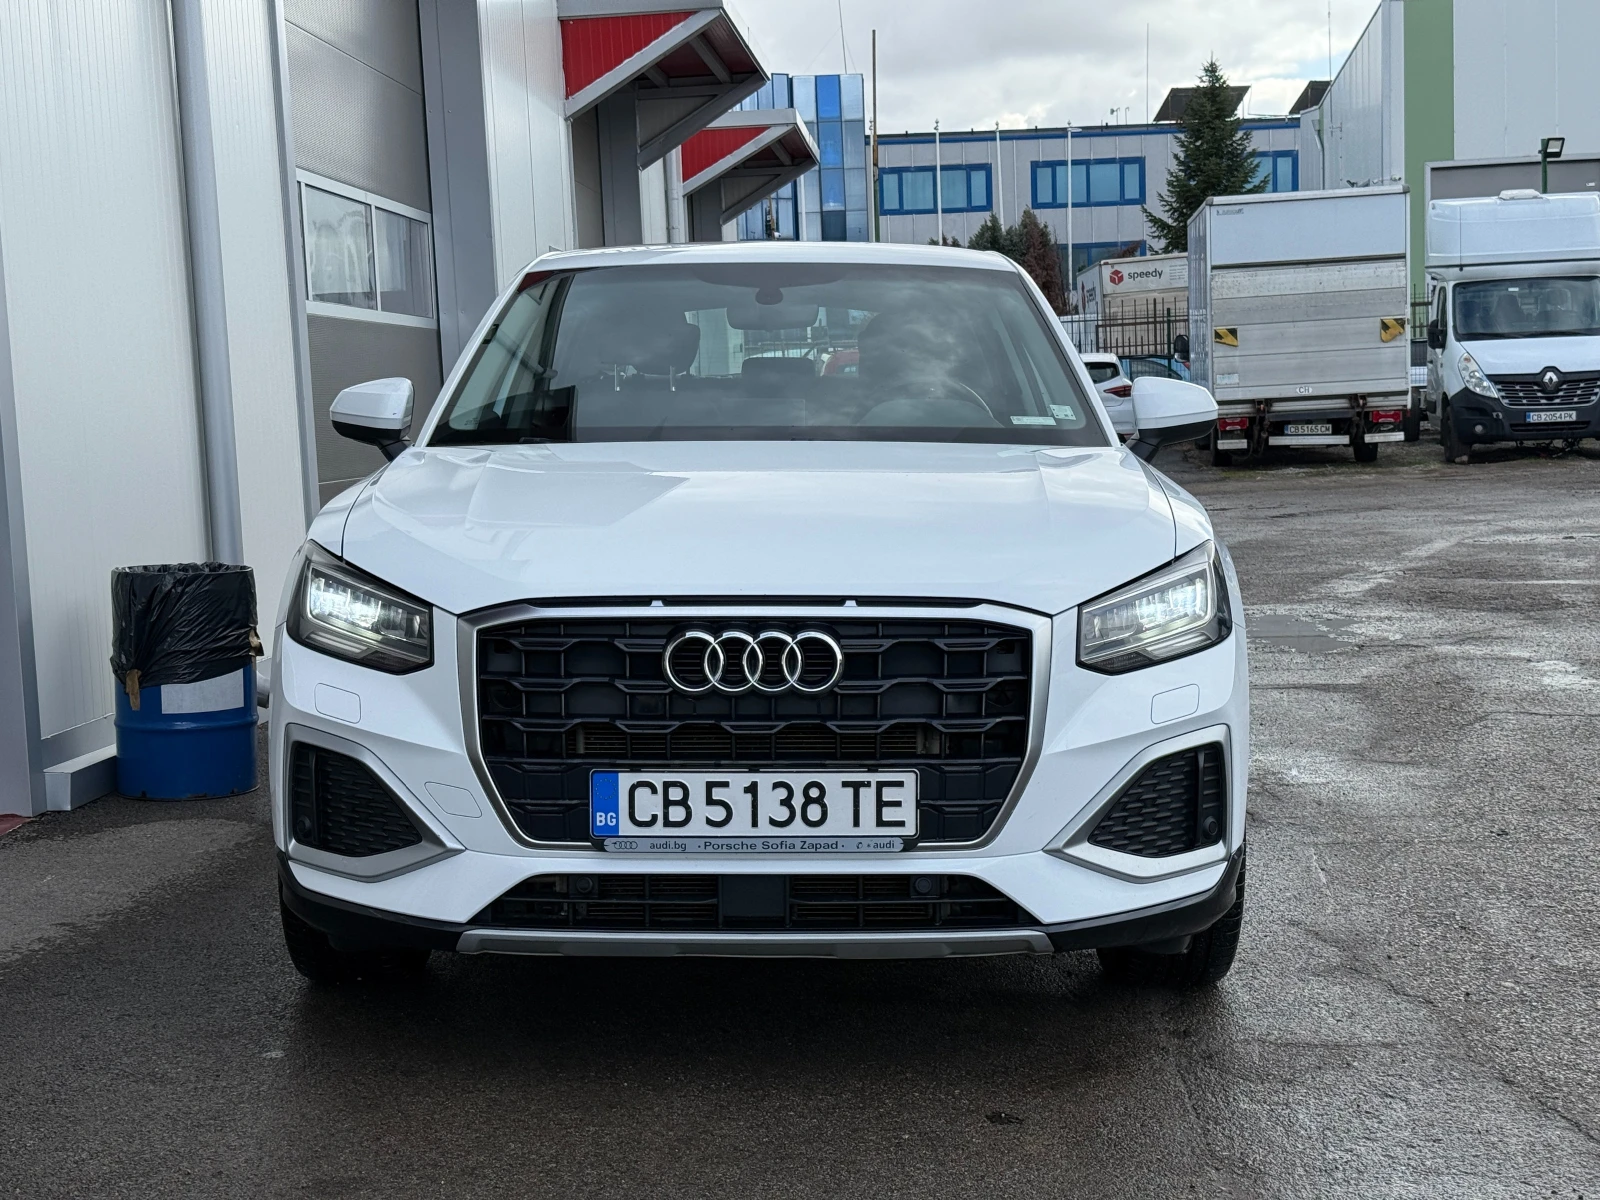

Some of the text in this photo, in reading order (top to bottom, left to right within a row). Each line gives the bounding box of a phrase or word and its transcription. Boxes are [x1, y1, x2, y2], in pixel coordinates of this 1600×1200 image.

[1127, 268, 1164, 281] speedy
[1298, 386, 1310, 394] CH
[1531, 412, 1574, 421] CB 2054 PK
[1289, 425, 1331, 434] CB 5165 CM
[628, 780, 906, 828] CB 5138 TE
[596, 812, 617, 827] BG
[649, 840, 687, 852] audi.bg
[703, 840, 757, 850] Porsche
[761, 840, 796, 850] Sofia
[800, 840, 839, 852] Zapad
